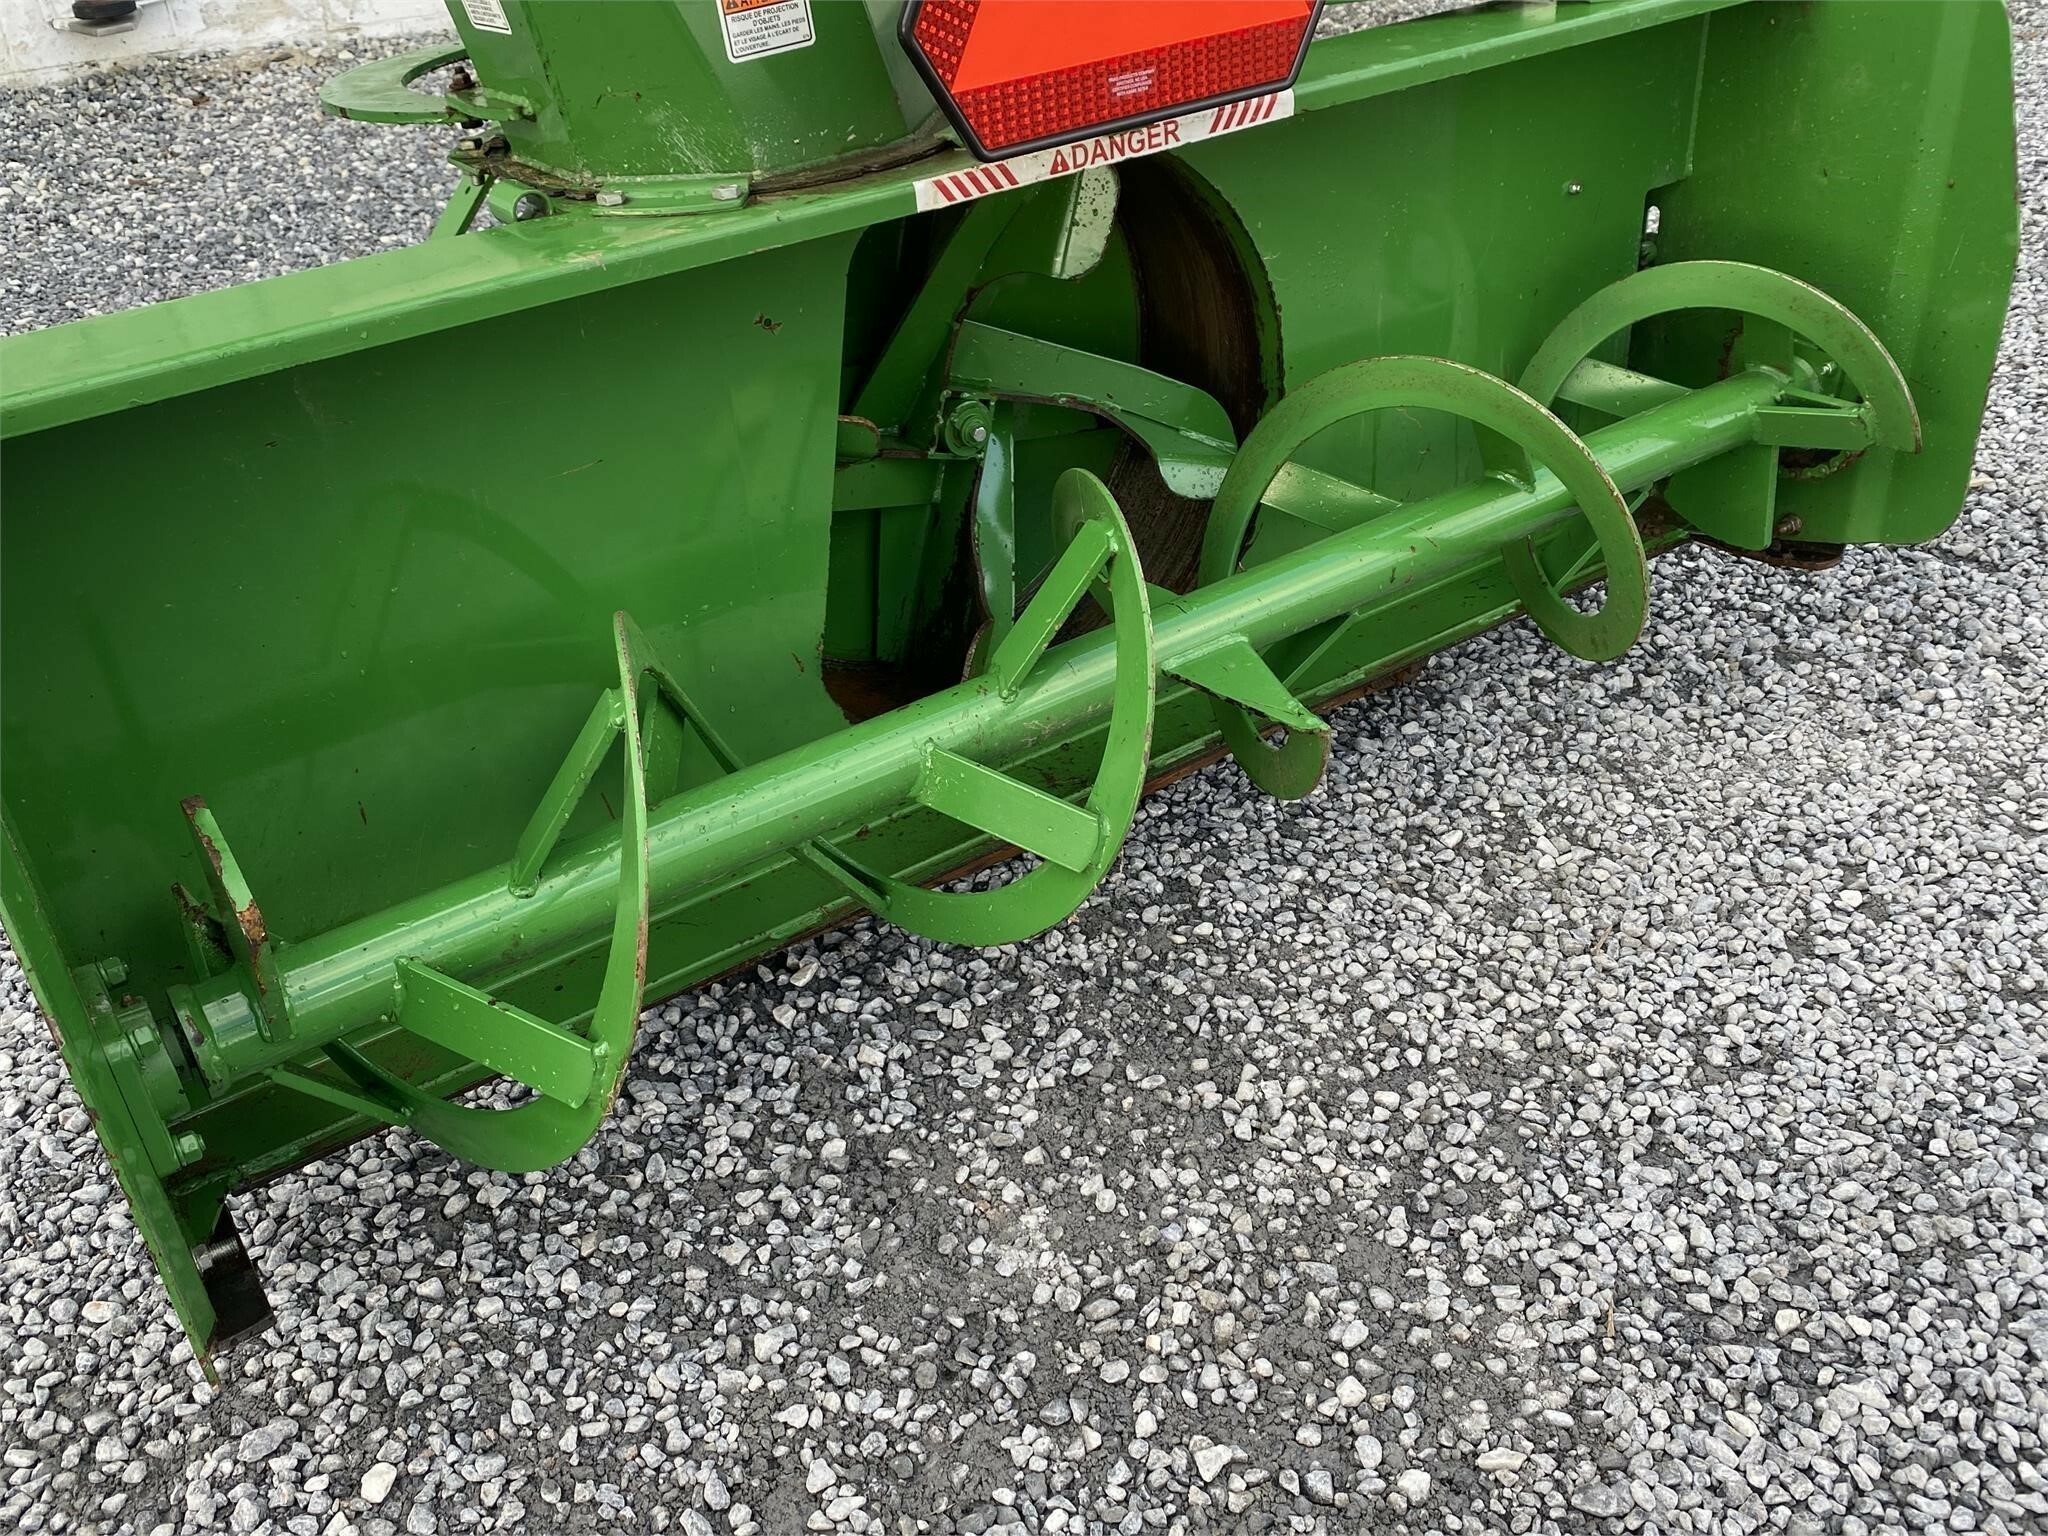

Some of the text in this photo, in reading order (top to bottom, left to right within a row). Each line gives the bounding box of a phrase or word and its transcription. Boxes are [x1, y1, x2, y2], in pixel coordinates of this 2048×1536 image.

[731, 13, 753, 23] RISQUE
[754, 10, 762, 18] DE
[763, 2, 799, 15] PROJECTION
[752, 14, 781, 27] D'OBJETS
[732, 29, 753, 39] GARDER
[749, 34, 766, 42] VISAGE
[1072, 119, 1182, 169] DANGER
